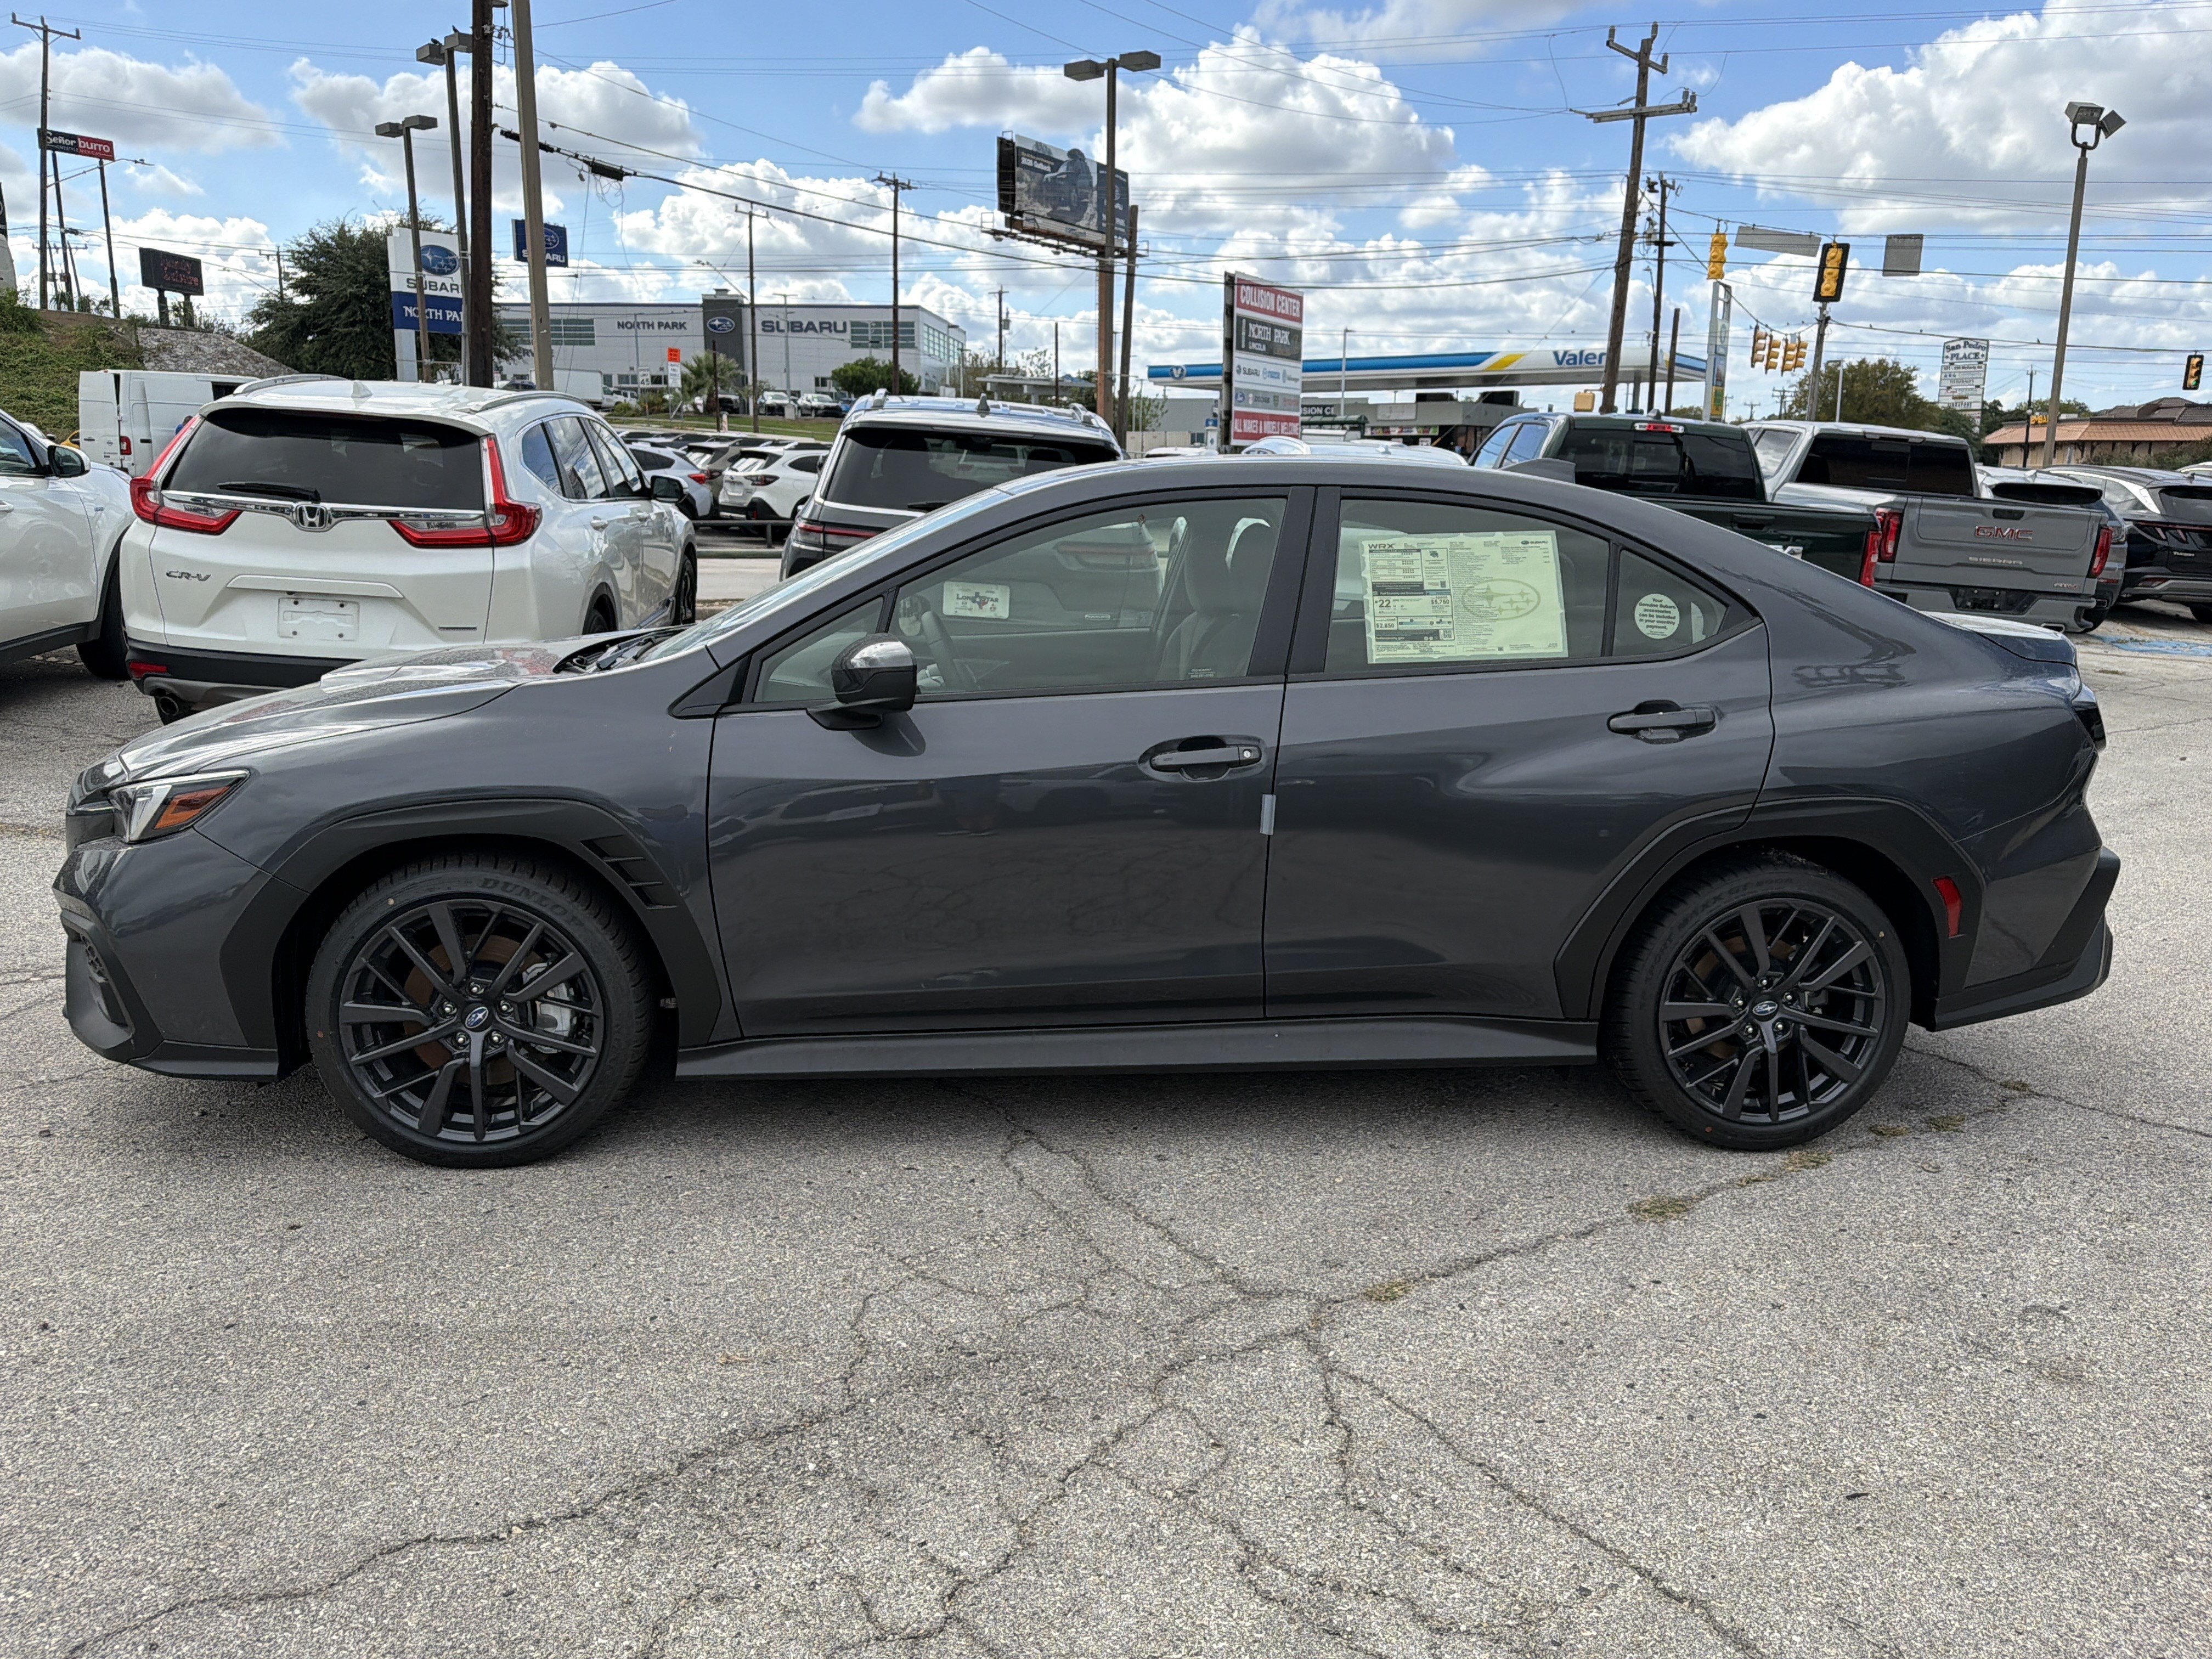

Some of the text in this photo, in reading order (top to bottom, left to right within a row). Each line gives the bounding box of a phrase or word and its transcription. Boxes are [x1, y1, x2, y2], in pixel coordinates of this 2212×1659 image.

[78, 137, 110, 153] burro
[522, 249, 566, 263] SARU
[406, 278, 462, 294] SBAR
[1240, 285, 1300, 318] COLLISION CENTER
[403, 305, 463, 323] NOTH PA
[617, 320, 687, 330] NORTH PARK
[761, 320, 847, 334] SUBARU
[1248, 322, 1290, 346] NORTH PARK
[1945, 341, 1987, 353] San Pedro
[1553, 349, 1606, 366] Valer
[1950, 352, 1980, 361] PLACE
[1302, 407, 1323, 415] SION
[2030, 415, 2050, 425] EMBA
[1976, 525, 2033, 542] GMC
[1968, 556, 2023, 565] SIERRA
[166, 569, 211, 582] CR-V
[1378, 599, 1392, 608] 22
[478, 877, 585, 927] DUNLOP
